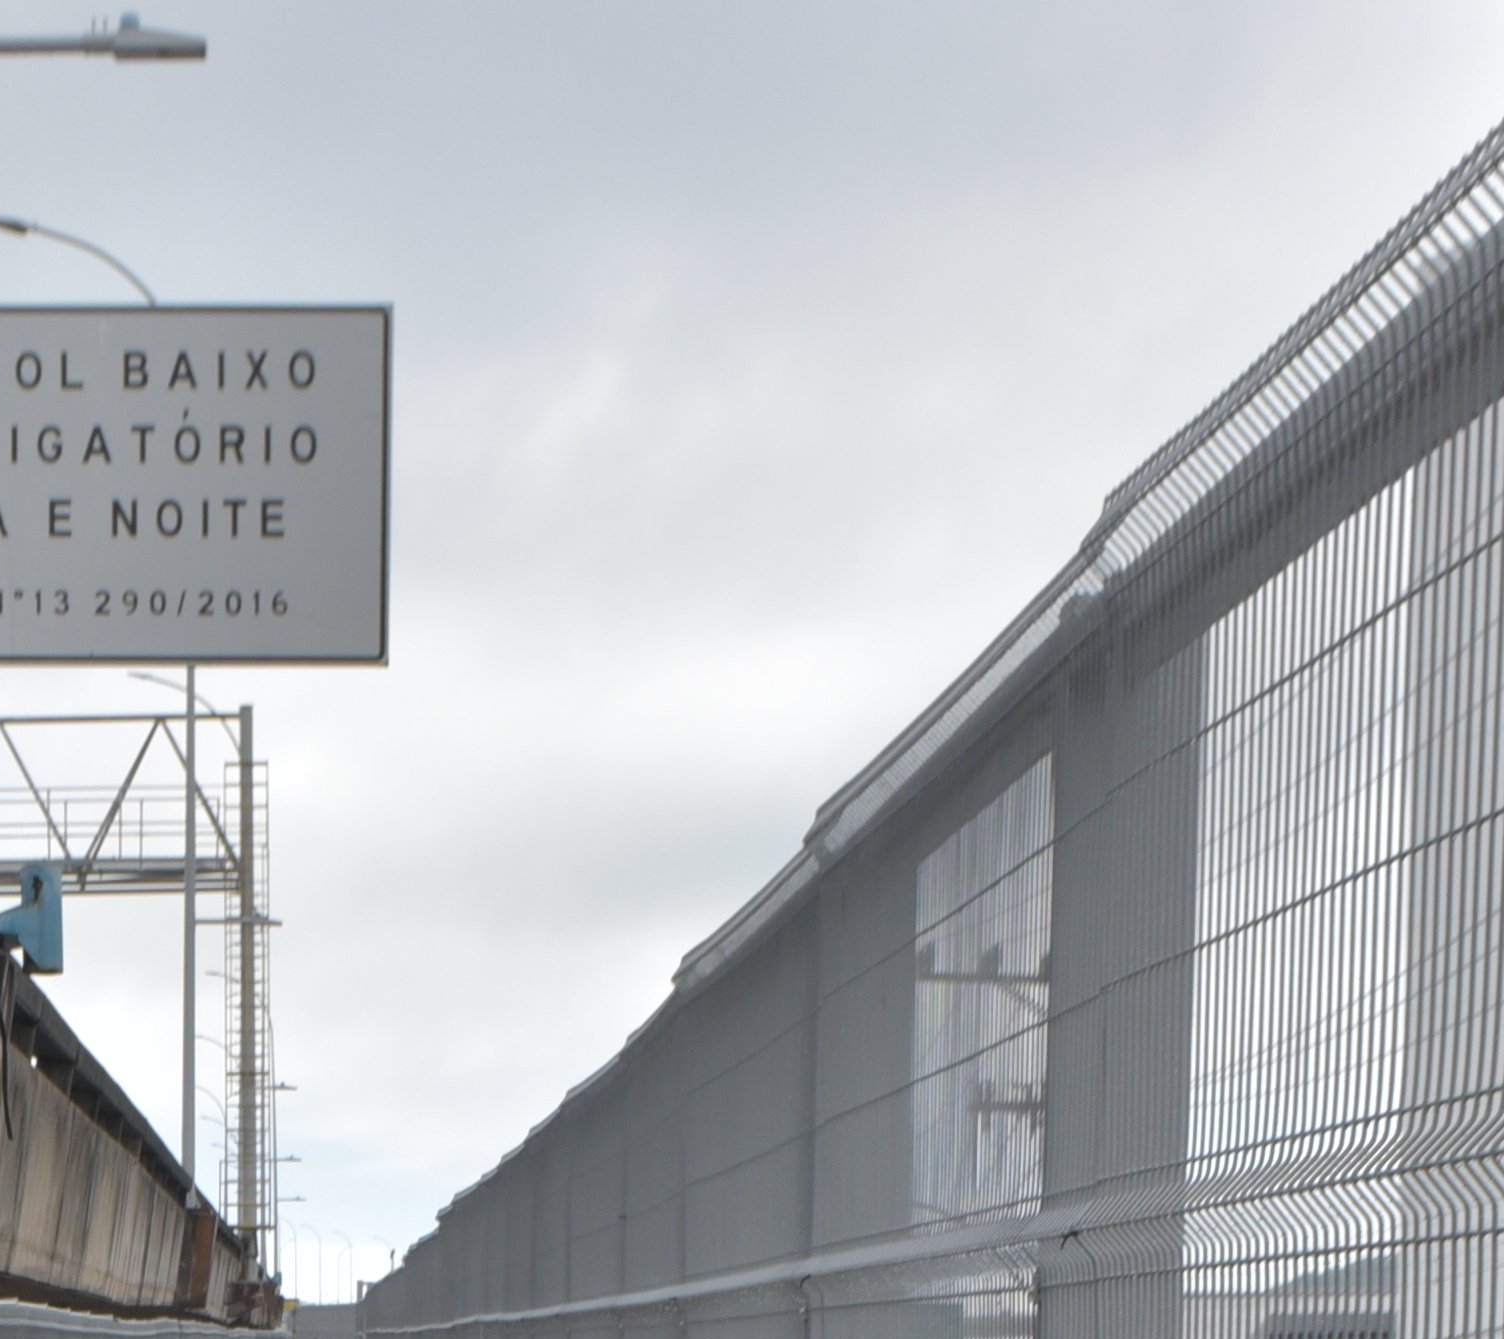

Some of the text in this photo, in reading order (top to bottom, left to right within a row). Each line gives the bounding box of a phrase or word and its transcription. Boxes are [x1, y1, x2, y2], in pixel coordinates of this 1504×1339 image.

[122, 348, 318, 393] BAIXO
[47, 496, 74, 540] E
[110, 496, 287, 541] NOITE
[93, 588, 290, 618] 290/2016
